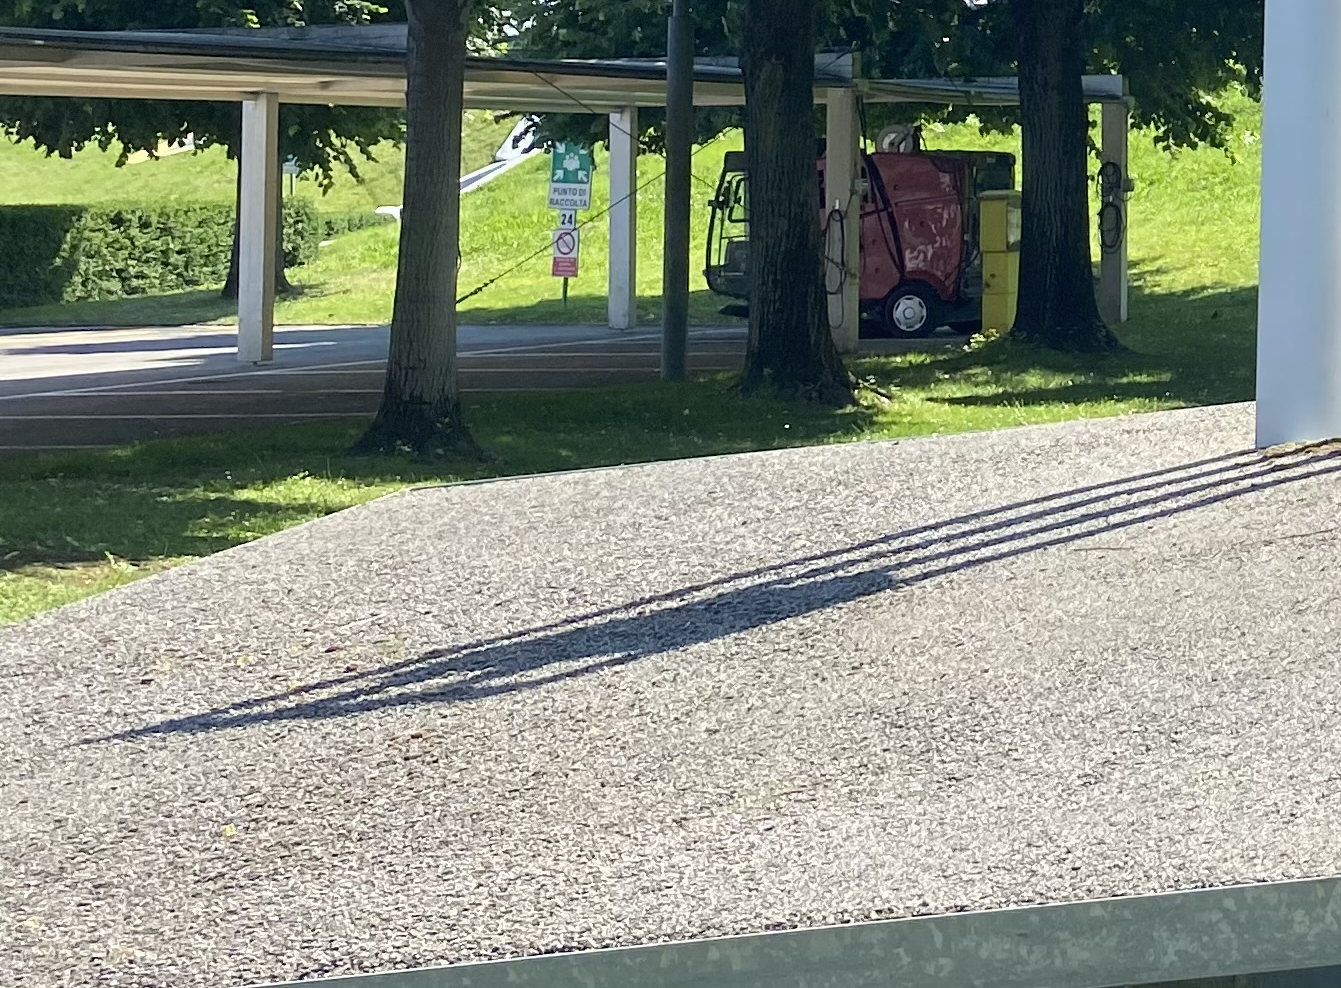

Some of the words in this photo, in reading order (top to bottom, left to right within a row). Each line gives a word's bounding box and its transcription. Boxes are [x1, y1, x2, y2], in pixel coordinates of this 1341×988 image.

[553, 187, 577, 197] PUNTO
[578, 188, 586, 197] DI
[549, 198, 588, 208] RACCOLTA
[561, 213, 573, 226] 24
